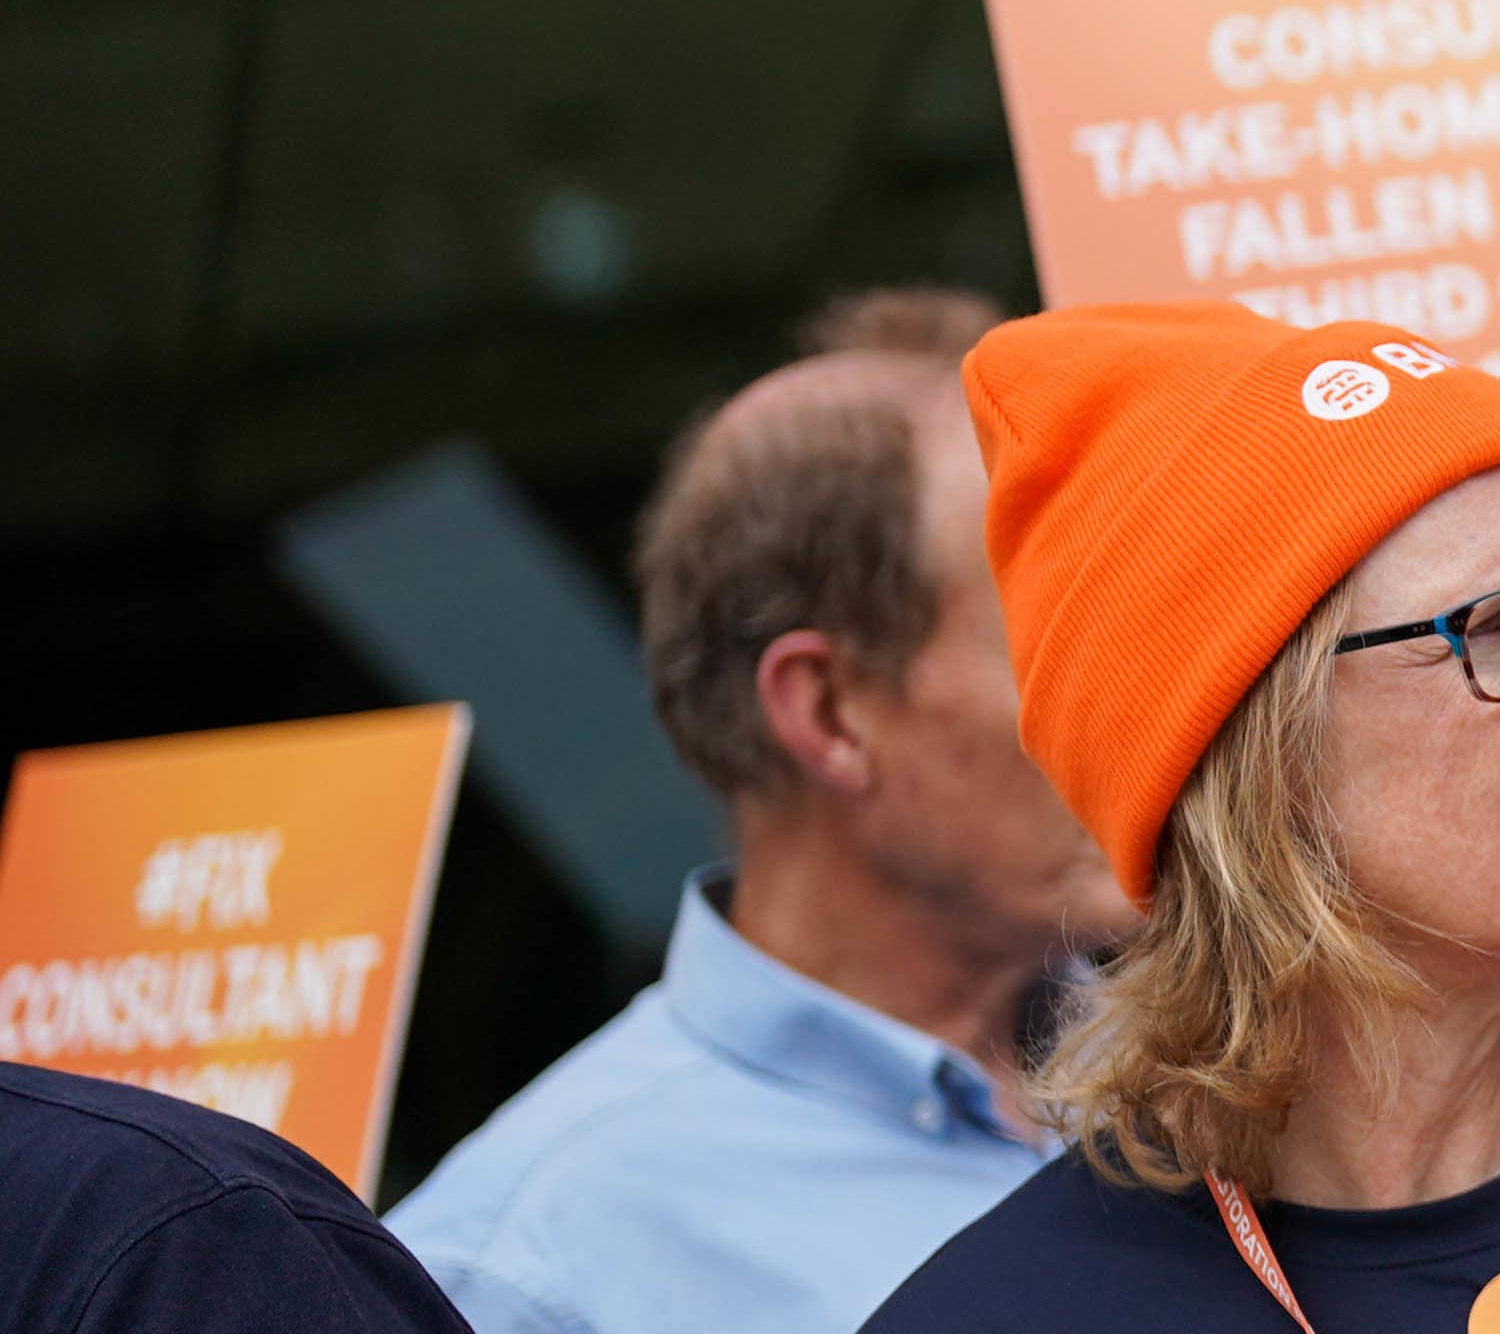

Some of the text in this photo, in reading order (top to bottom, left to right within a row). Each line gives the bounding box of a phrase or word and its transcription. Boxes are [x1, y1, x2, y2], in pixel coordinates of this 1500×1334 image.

[1182, 168, 1494, 276] FALLEN
[135, 828, 284, 933] #FIX
[0, 935, 384, 1059] CONSULTANT
